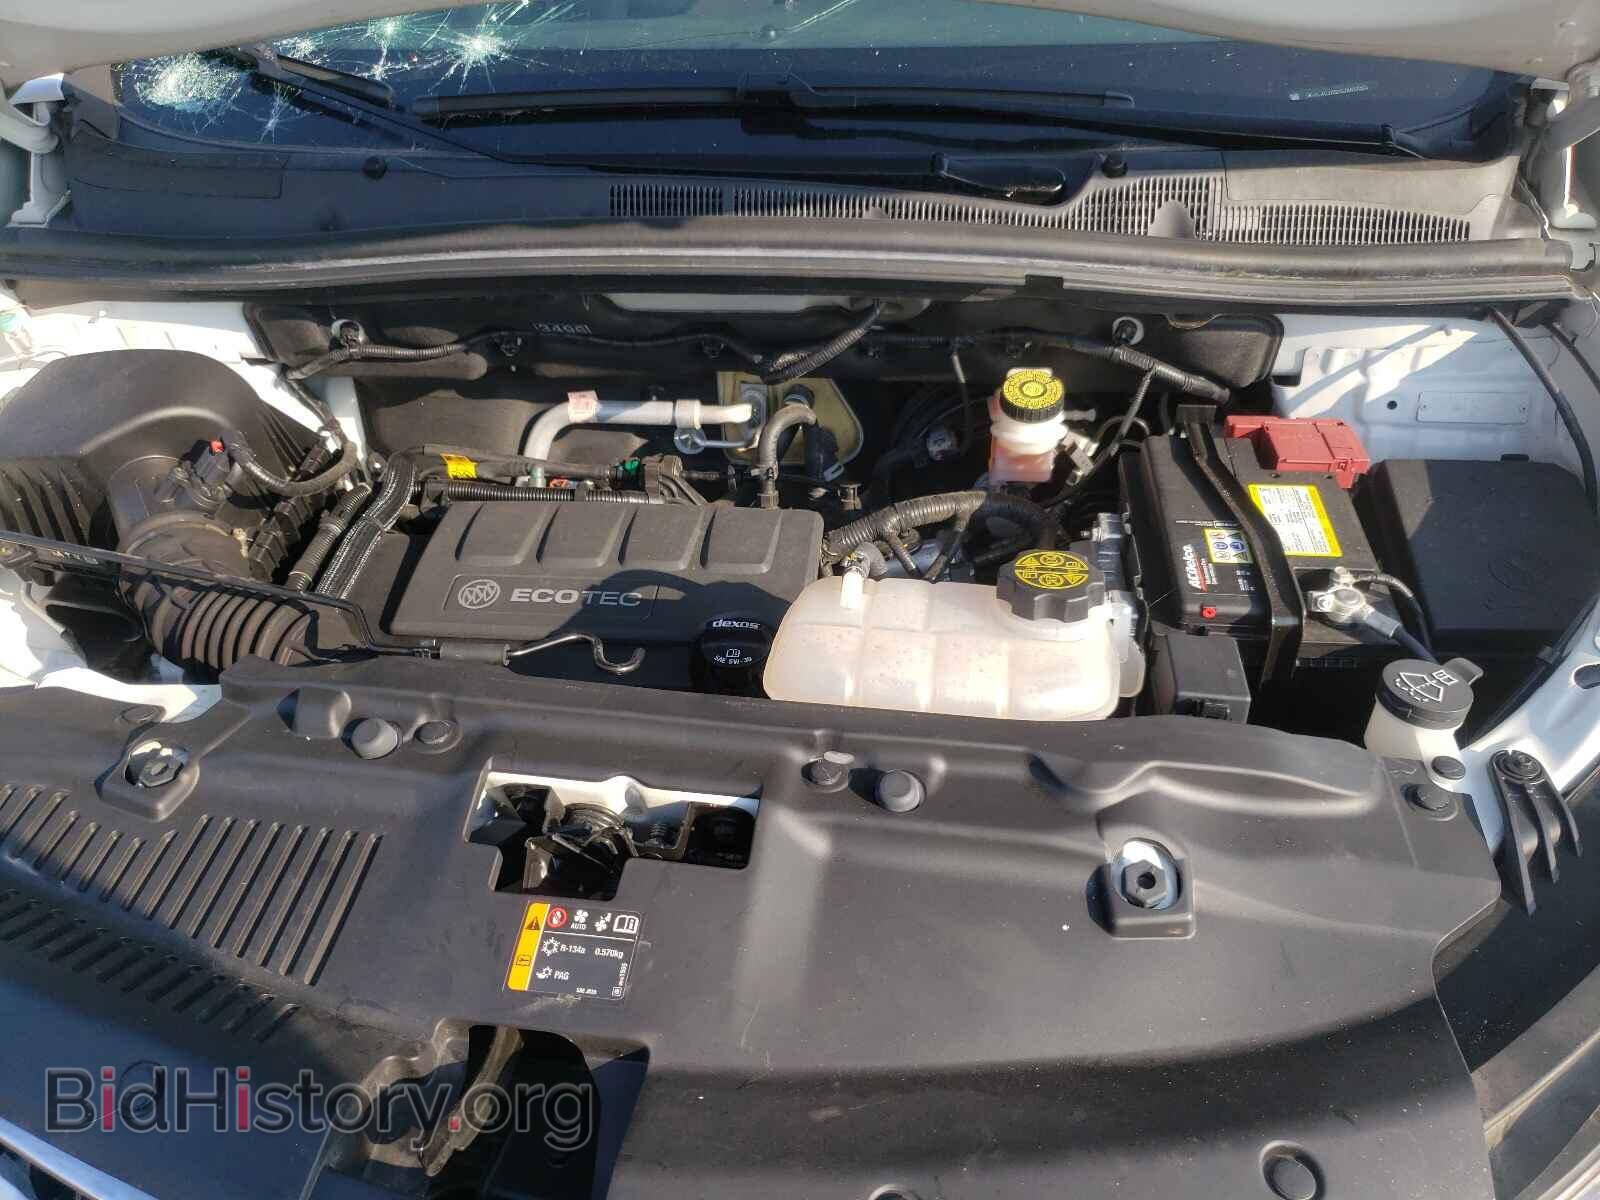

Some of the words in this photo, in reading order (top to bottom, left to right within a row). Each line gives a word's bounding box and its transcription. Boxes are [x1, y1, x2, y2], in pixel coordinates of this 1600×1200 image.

[510, 588, 642, 607] ECOTEC
[712, 619, 761, 630] dexos
[559, 944, 586, 955] R-134a
[594, 947, 624, 960] 0.570kg
[554, 971, 570, 981] PAG
